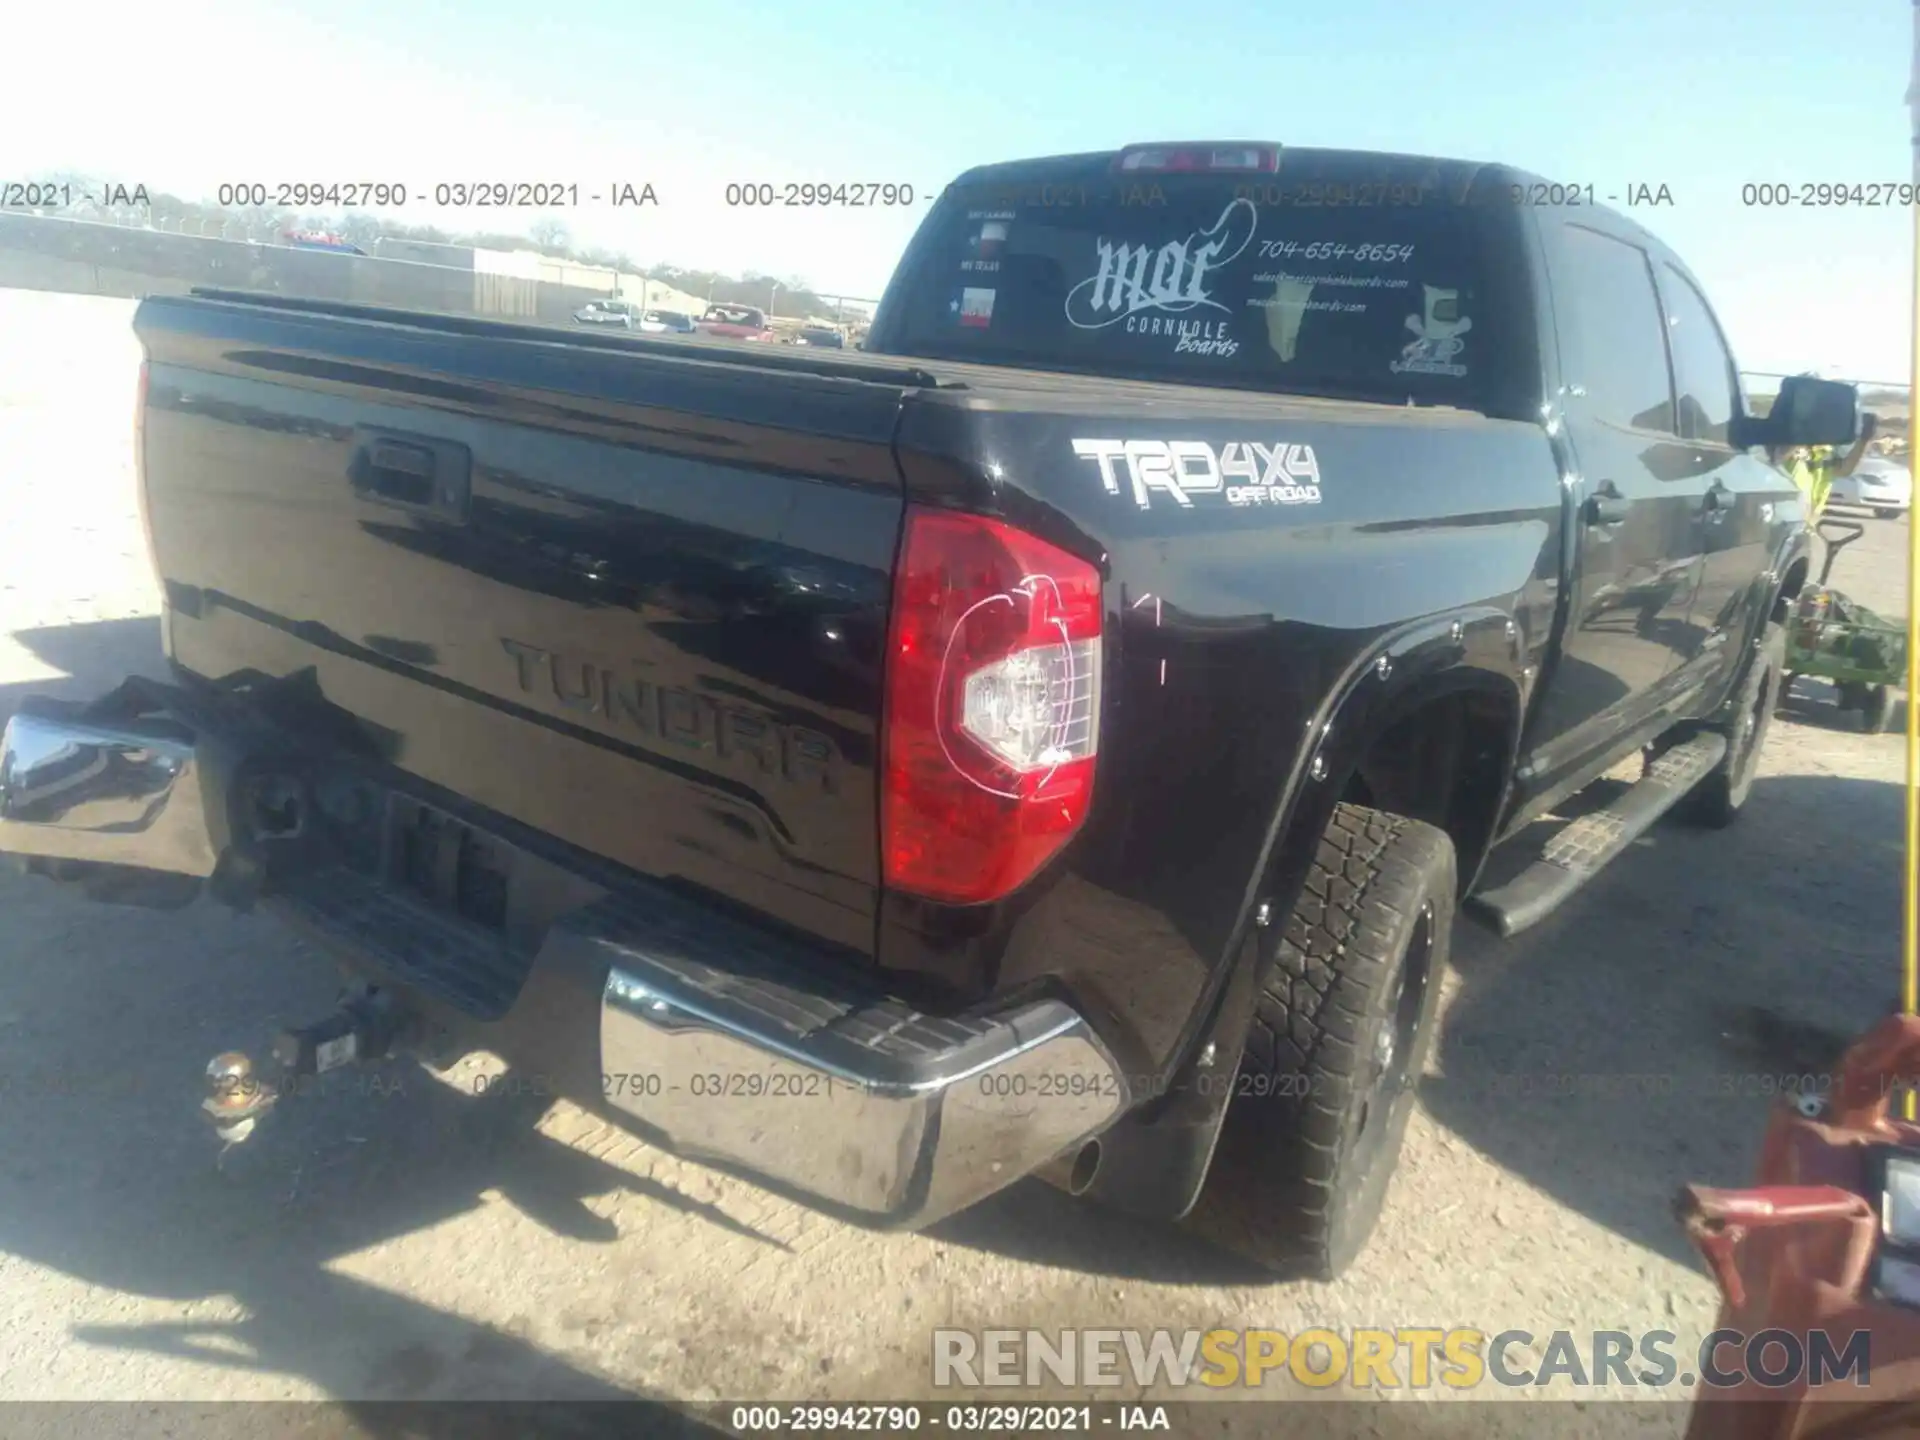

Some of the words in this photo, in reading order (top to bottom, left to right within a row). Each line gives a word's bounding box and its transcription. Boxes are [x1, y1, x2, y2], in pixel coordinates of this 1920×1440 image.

[1258, 239, 1415, 262] 704-654-8654
[1126, 316, 1228, 339] CORNHOLE
[1071, 438, 1224, 510] TRD
[1219, 442, 1321, 486] 4X4
[1226, 485, 1268, 506] OFF
[1270, 486, 1322, 506] ROAD
